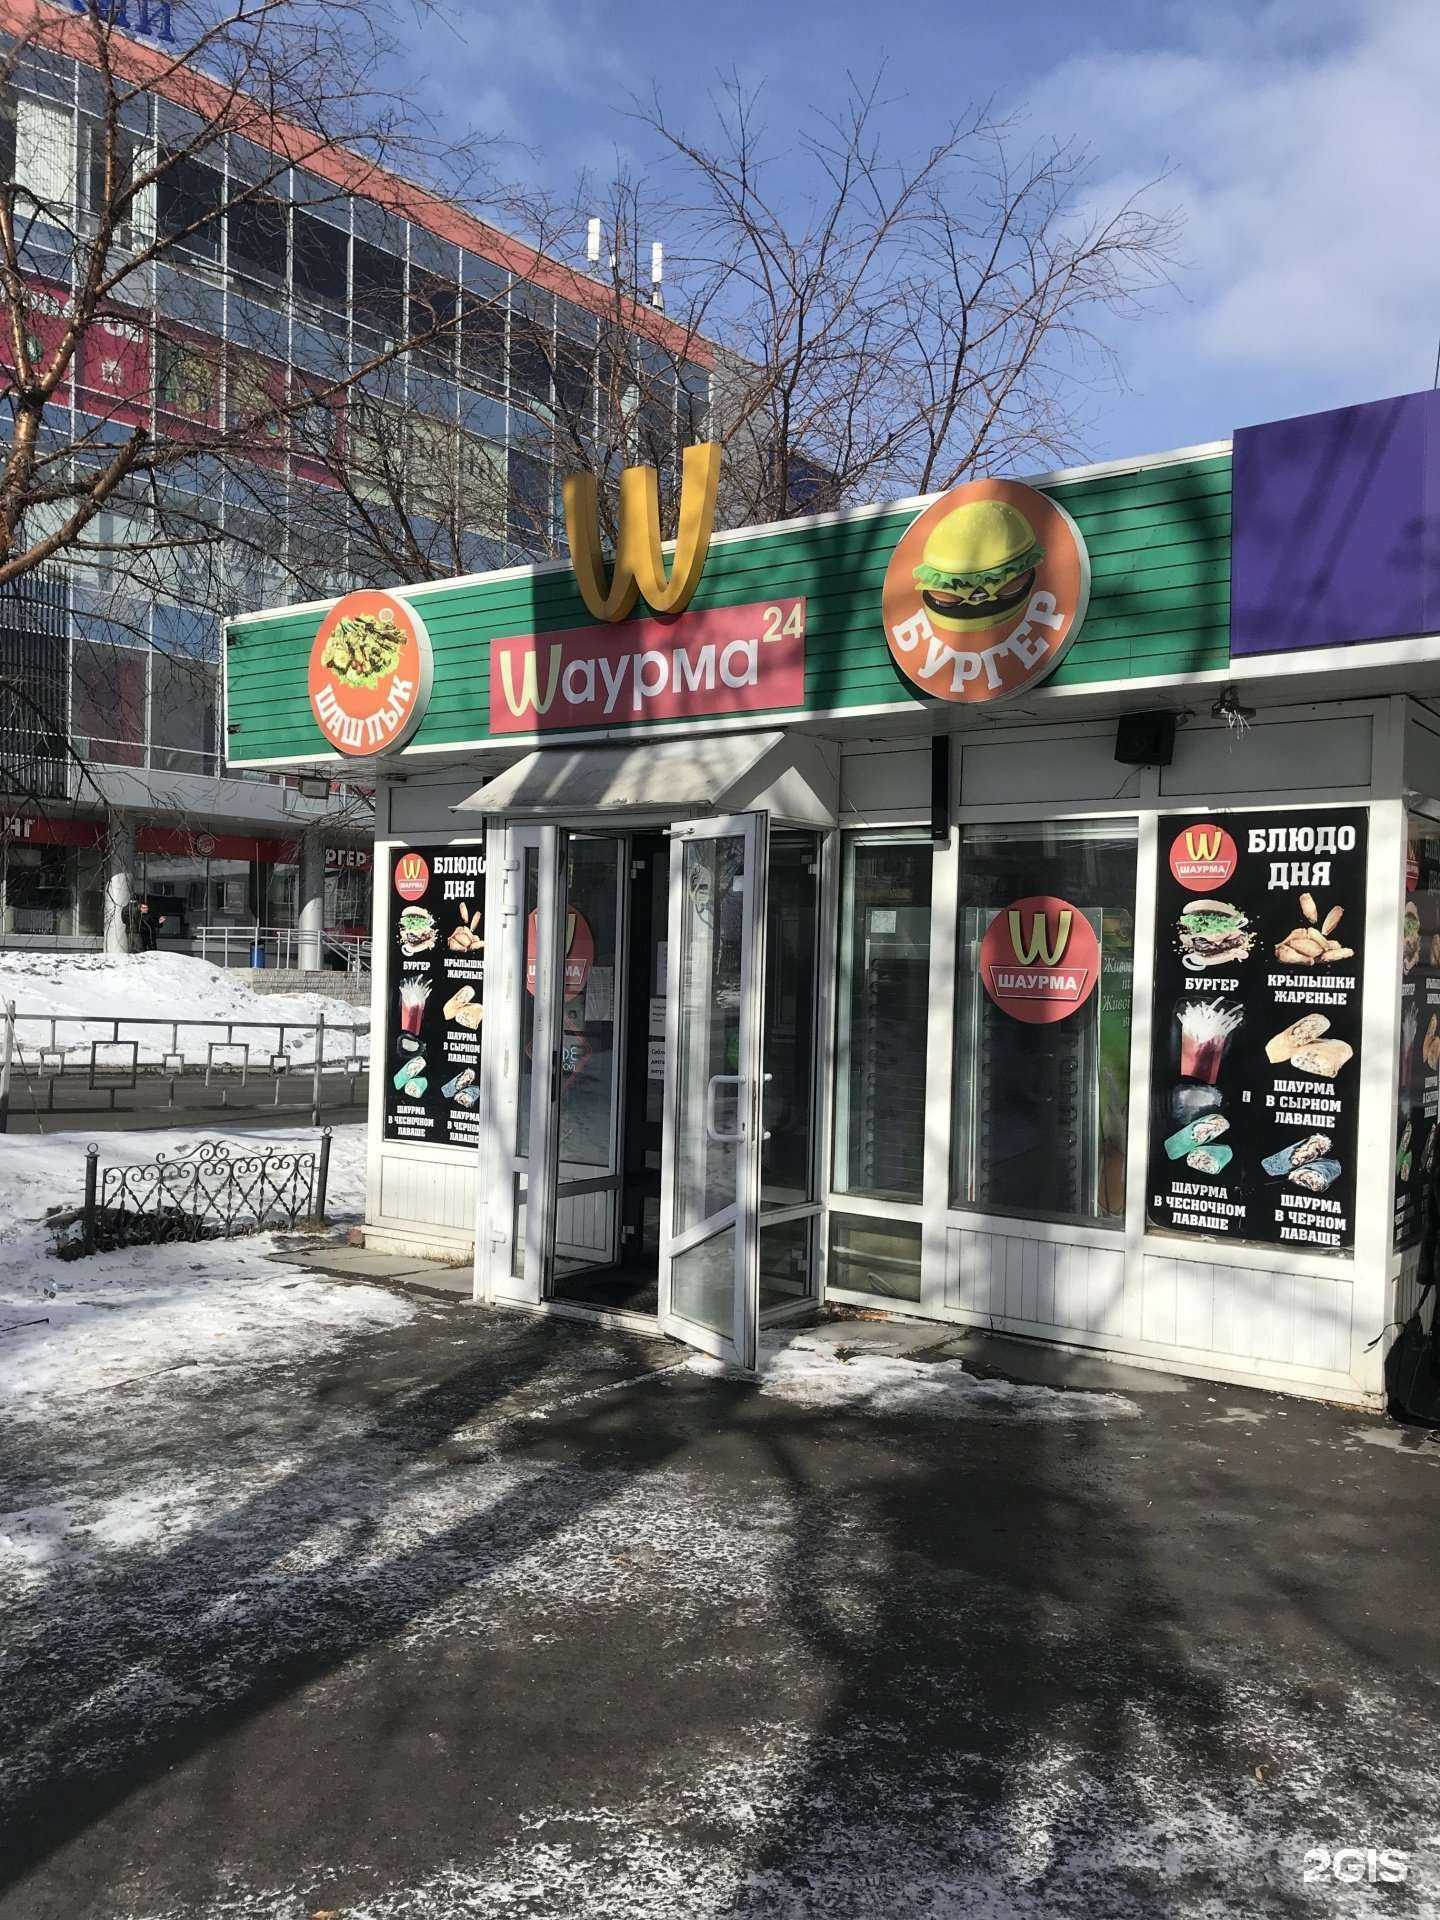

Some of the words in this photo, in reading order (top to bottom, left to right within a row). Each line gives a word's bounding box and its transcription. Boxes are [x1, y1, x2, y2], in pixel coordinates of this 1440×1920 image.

[762, 603, 804, 642] 24
[892, 591, 1064, 693] БУРГЕР
[315, 675, 413, 748] ШАШЛЫК
[1248, 825, 1356, 855] БЛЮДО
[1179, 865, 1226, 875] ШАУРМА
[1267, 861, 1331, 890] ДНЯ
[444, 880, 475, 900] ДНЯ
[403, 961, 431, 971] БУРГЕР
[998, 974, 1078, 990] ШАУРМА
[1184, 977, 1240, 992] БУРГЕР
[1267, 974, 1356, 990] КРЫЛЫШКИ
[1274, 990, 1347, 1006] ЖАРЕНЫЕ
[447, 1031, 478, 1042] ШАУРМА
[1273, 1079, 1335, 1096] ШАУРМА
[397, 1105, 426, 1116] ШАУРМА
[1266, 1094, 1275, 1107] В
[1279, 1095, 1342, 1113] СЫРНОМ
[1275, 1111, 1336, 1128] ЛАВАШЕ
[1171, 1181, 1228, 1200] ШАУРМА
[1154, 1195, 1163, 1207] В
[1165, 1195, 1247, 1217] ЧЕСНОЧНОМ
[1280, 1194, 1342, 1214] ШАУРМА
[1172, 1211, 1229, 1231] ЛАВАШЕ
[1274, 1209, 1284, 1222] В
[1288, 1211, 1347, 1231] ЧЕРНОМ
[1280, 1226, 1341, 1246] ЛАВАШЕ
